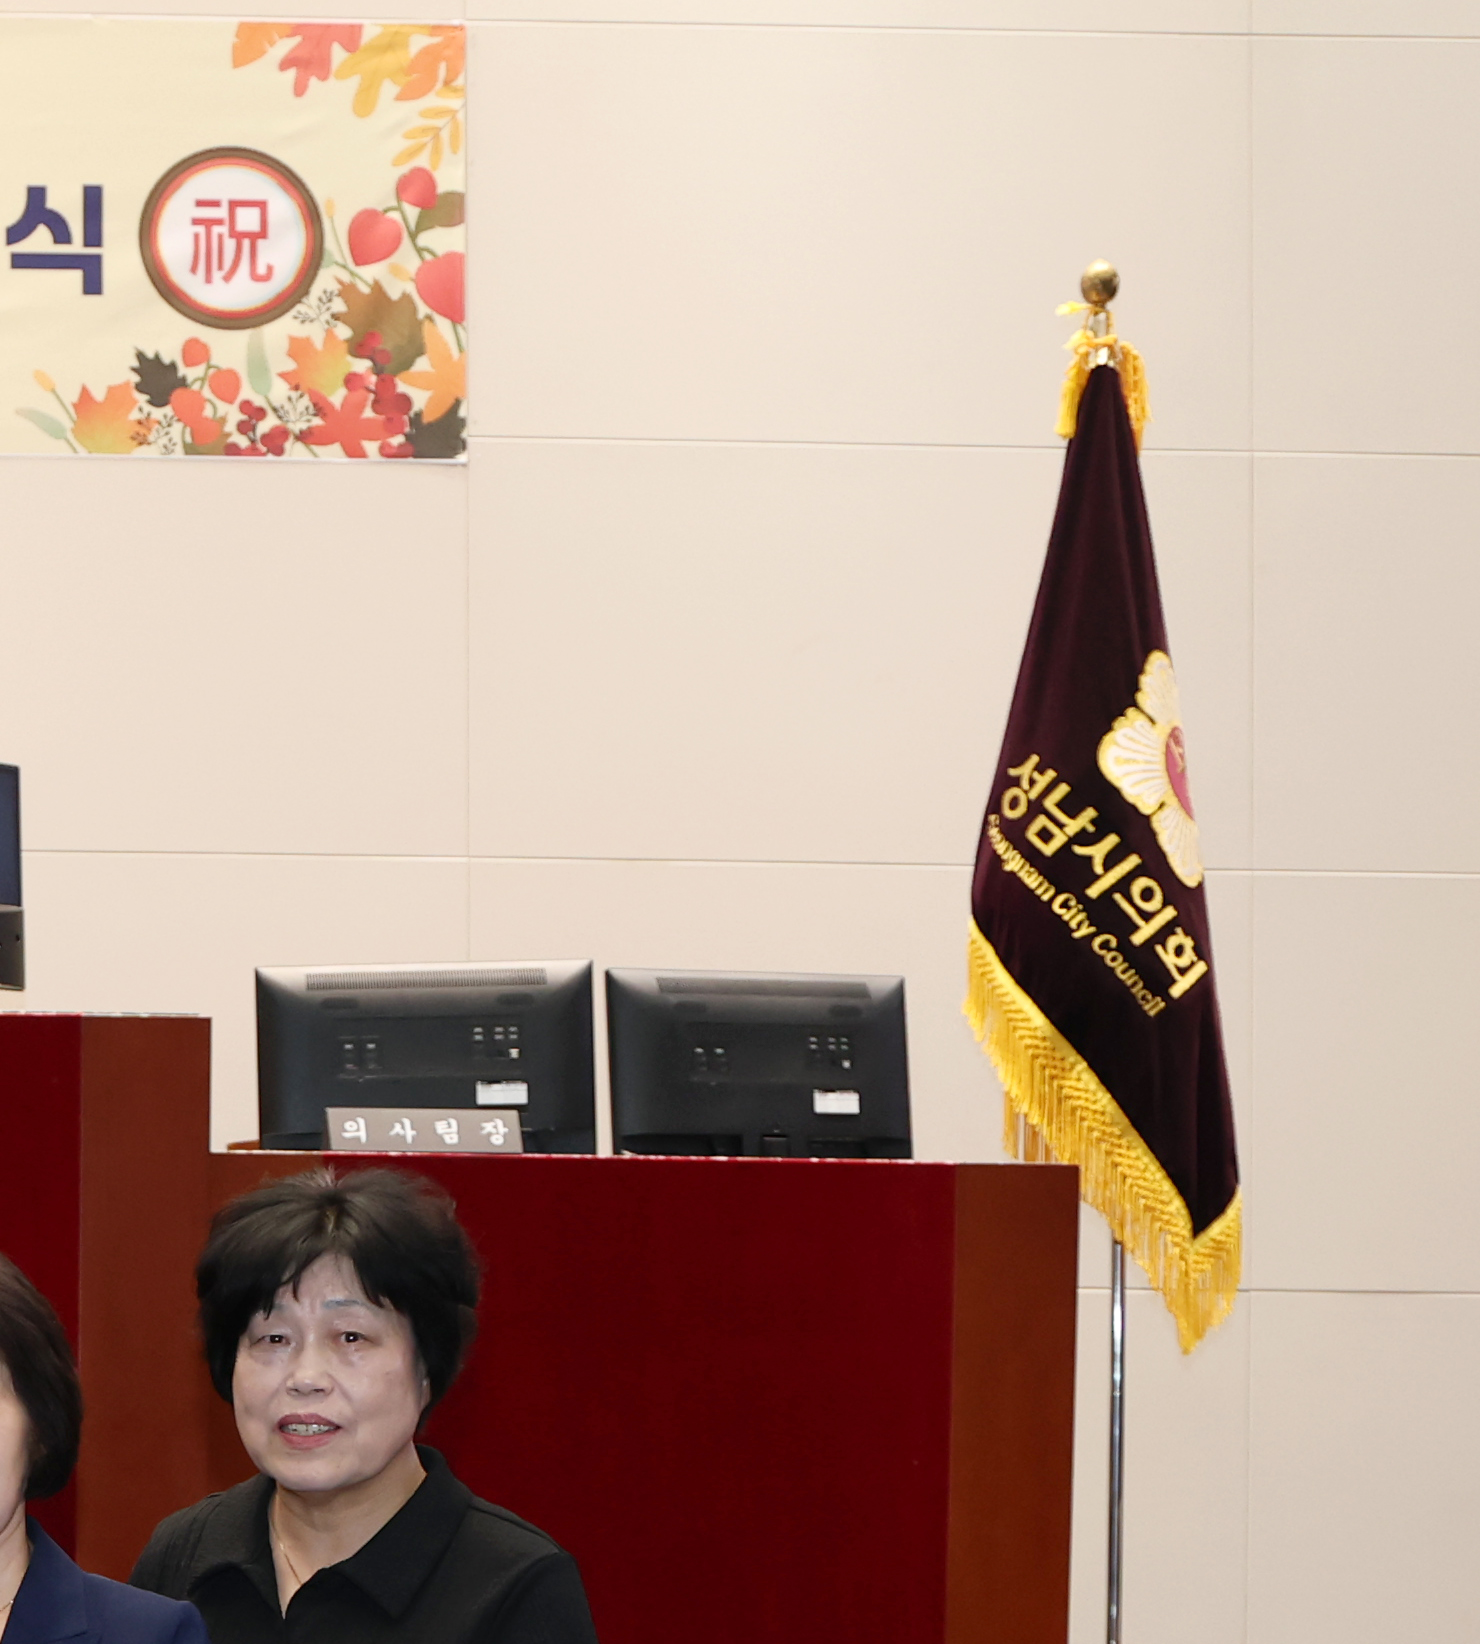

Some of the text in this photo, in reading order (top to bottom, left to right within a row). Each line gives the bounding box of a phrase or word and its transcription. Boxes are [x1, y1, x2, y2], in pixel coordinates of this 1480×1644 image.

[189, 198, 274, 285] 祝
[1001, 753, 1208, 999] 성남시의회
[1051, 892, 1097, 939] City
[1091, 933, 1166, 1017] Council
